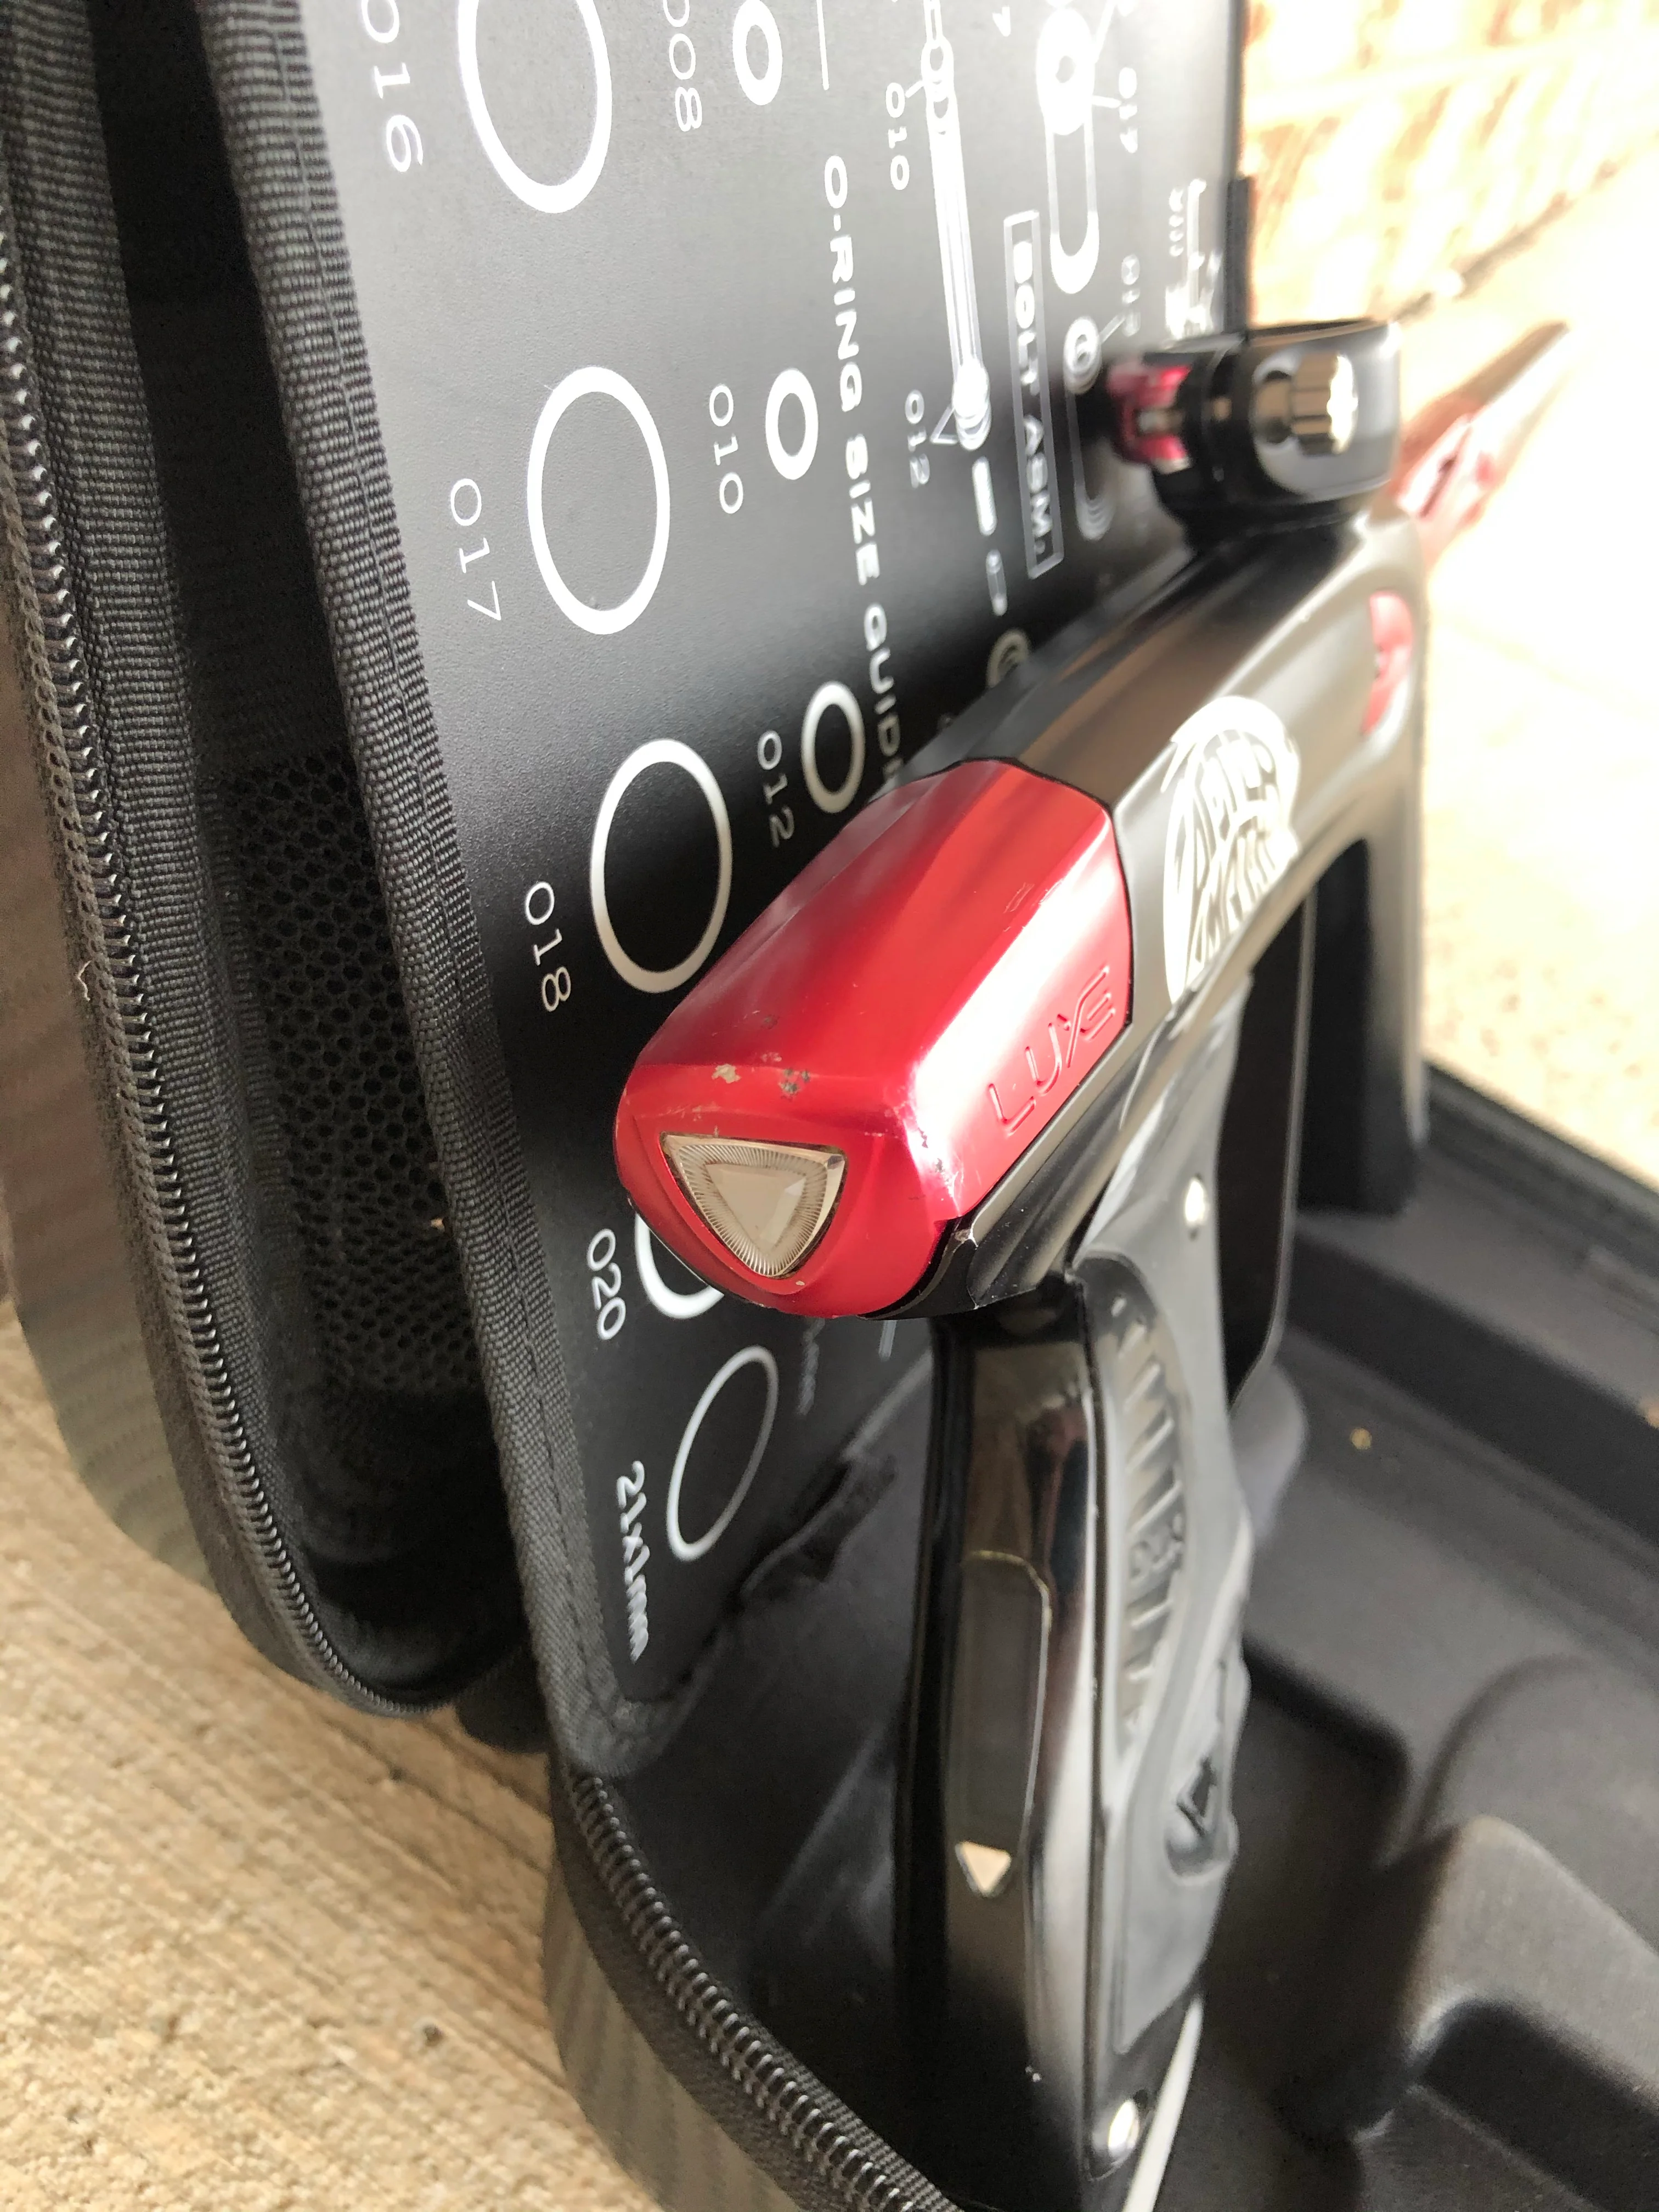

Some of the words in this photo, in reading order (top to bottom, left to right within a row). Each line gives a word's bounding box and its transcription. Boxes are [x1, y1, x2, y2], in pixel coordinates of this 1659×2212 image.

[361, 0, 424, 173] 016
[663, 0, 703, 132] 008
[885, 82, 911, 190] 010
[824, 155, 862, 413] O-RING
[845, 433, 879, 585] SIZE
[709, 384, 744, 514] 010
[905, 389, 930, 489] 012
[450, 478, 502, 621] 017
[757, 730, 795, 848] 012
[524, 881, 572, 1012] 018
[987, 966, 1116, 1137] LUXE
[587, 1229, 626, 1340] 020
